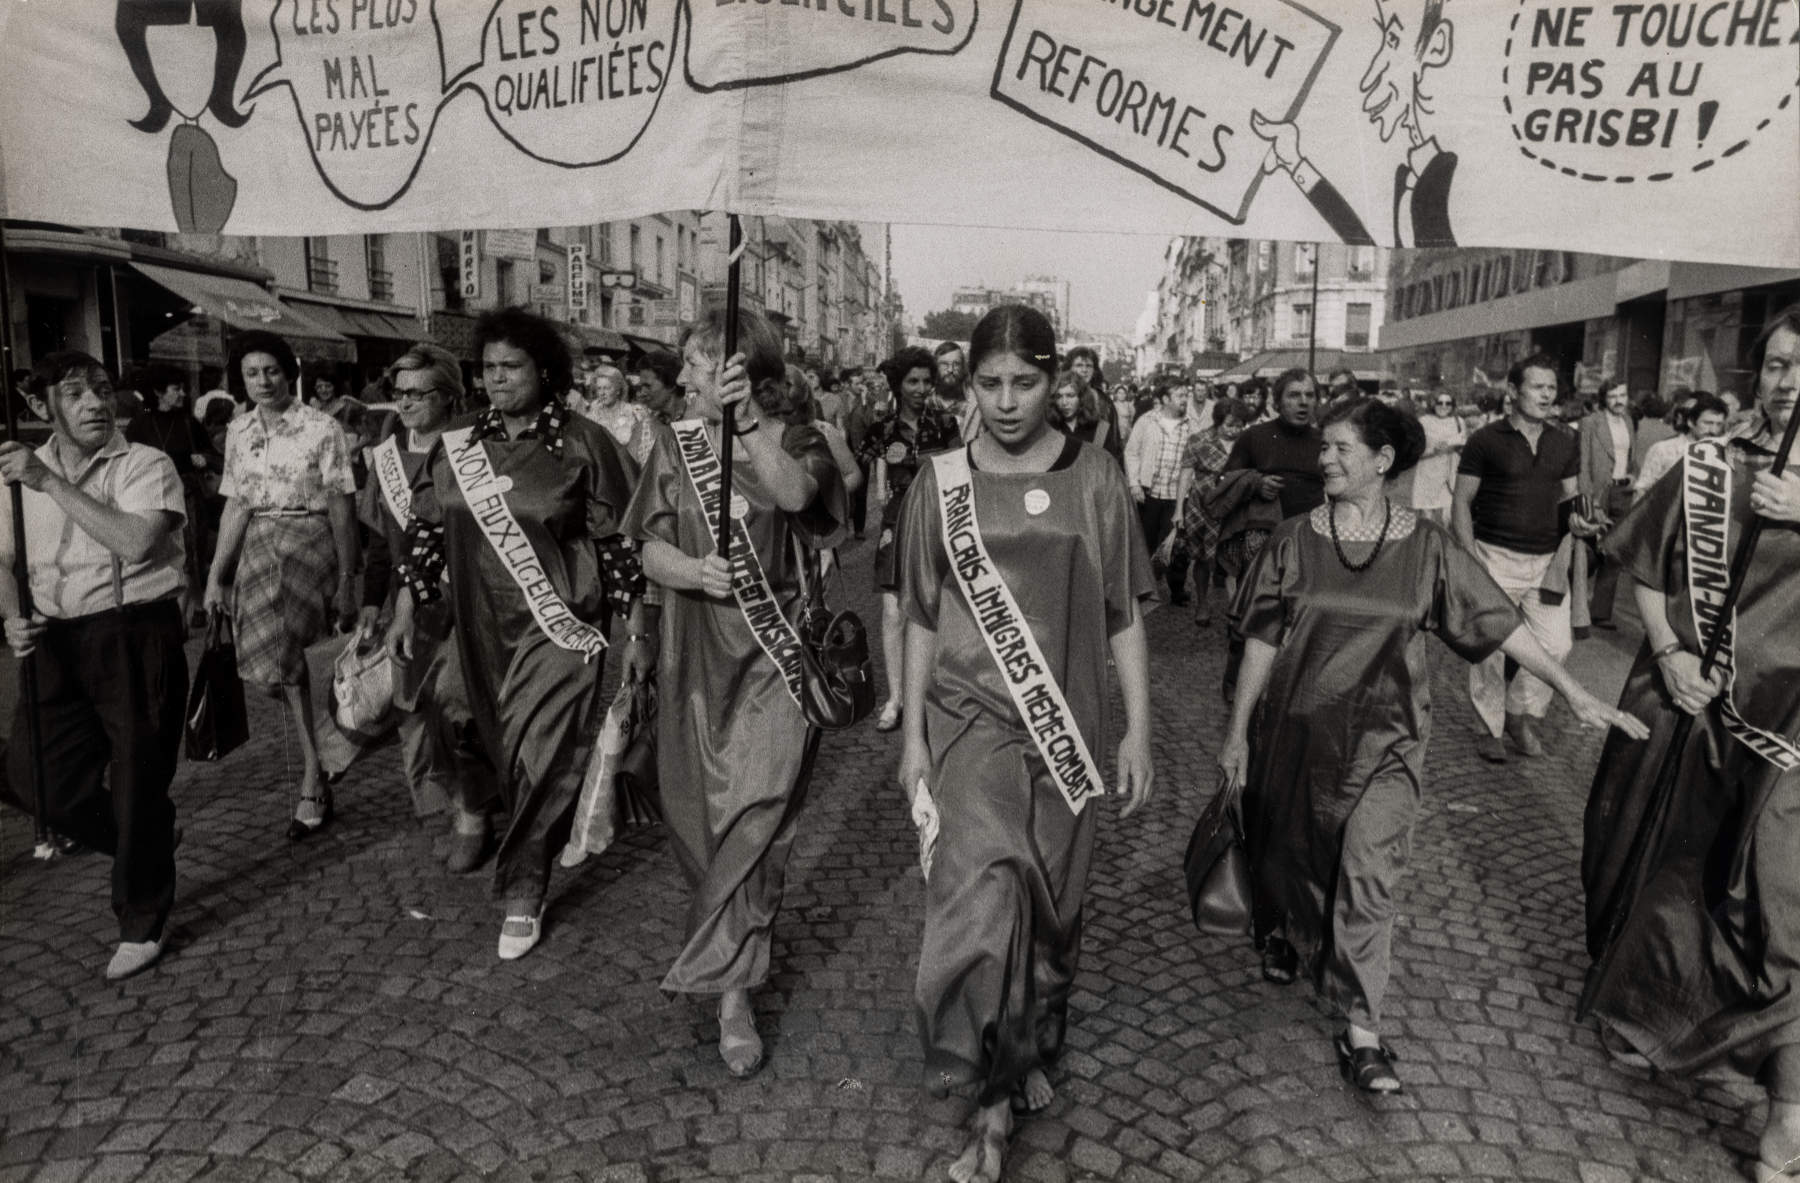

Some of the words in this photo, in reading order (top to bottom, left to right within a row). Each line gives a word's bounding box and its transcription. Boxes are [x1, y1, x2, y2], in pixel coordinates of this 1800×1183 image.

[293, 0, 339, 36] LES
[352, 0, 417, 30] PLUS
[497, 5, 560, 61] LES
[581, 0, 647, 45] NON
[1531, 7, 1593, 47] NE
[1612, 0, 1800, 47] TOUCHE
[323, 55, 389, 99] MAL
[495, 40, 665, 116] QUALIFIÉES
[1526, 61, 1604, 99] PAS
[1626, 61, 1703, 98] AU
[1016, 30, 1233, 172] REFORMES
[315, 100, 420, 151] PAYÉES
[1525, 108, 1679, 148] GRISBI
[570, 246, 584, 307] PARFUMS
[452, 446, 493, 491] NON
[677, 426, 714, 465] NON
[690, 462, 716, 479] A
[472, 493, 520, 549] AUX
[505, 542, 606, 652] LICENCIEMENTS
[738, 582, 768, 603] ET
[745, 600, 785, 637] AUX
[1020, 683, 1067, 743] MEME
[1046, 732, 1095, 802] COMBAT
